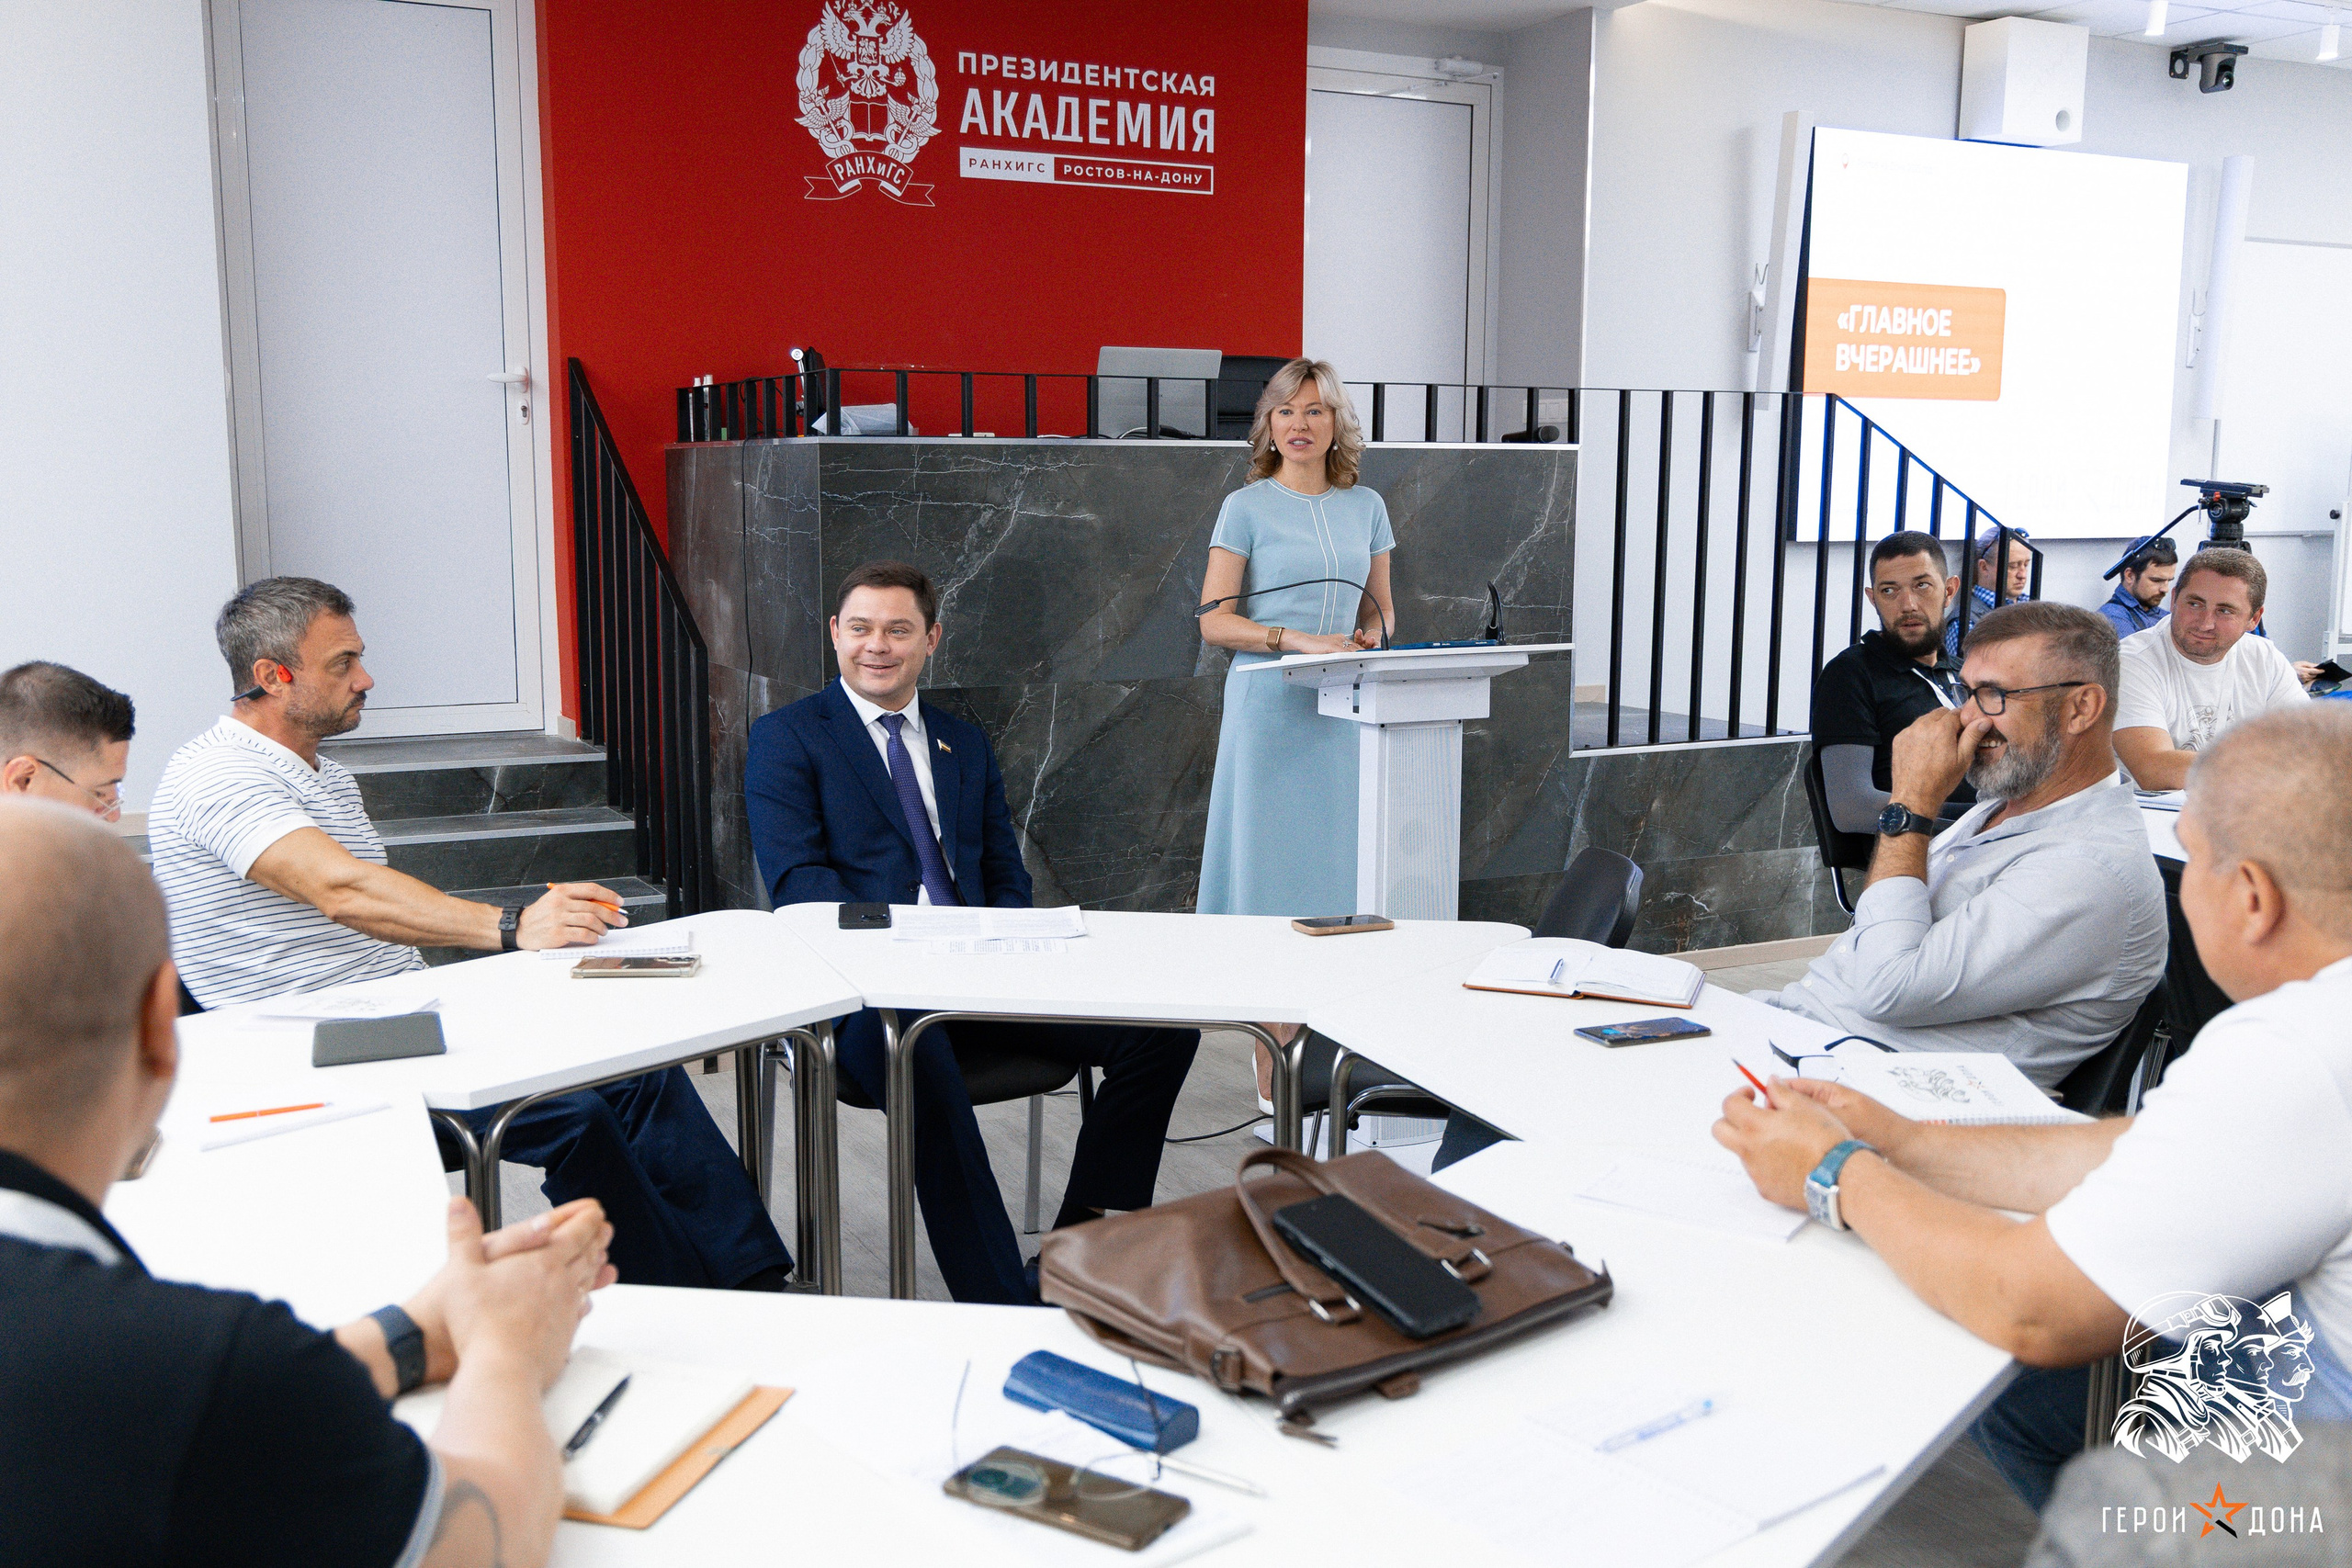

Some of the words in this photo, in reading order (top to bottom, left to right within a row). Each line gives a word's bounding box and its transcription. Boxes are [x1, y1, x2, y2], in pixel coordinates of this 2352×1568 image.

[958, 51, 1216, 97] ПРЕЗИДЕНТСКАЯ
[959, 87, 1215, 153] АКАДЕМИЯ
[968, 157, 1046, 173] РАНХИГС
[1063, 164, 1203, 185] РОСТОВ-НА-ДОНУ
[1838, 304, 1952, 337] «ГЛАВНОЕ
[1836, 343, 1982, 376] ВЧЕРАШНЕЕ»
